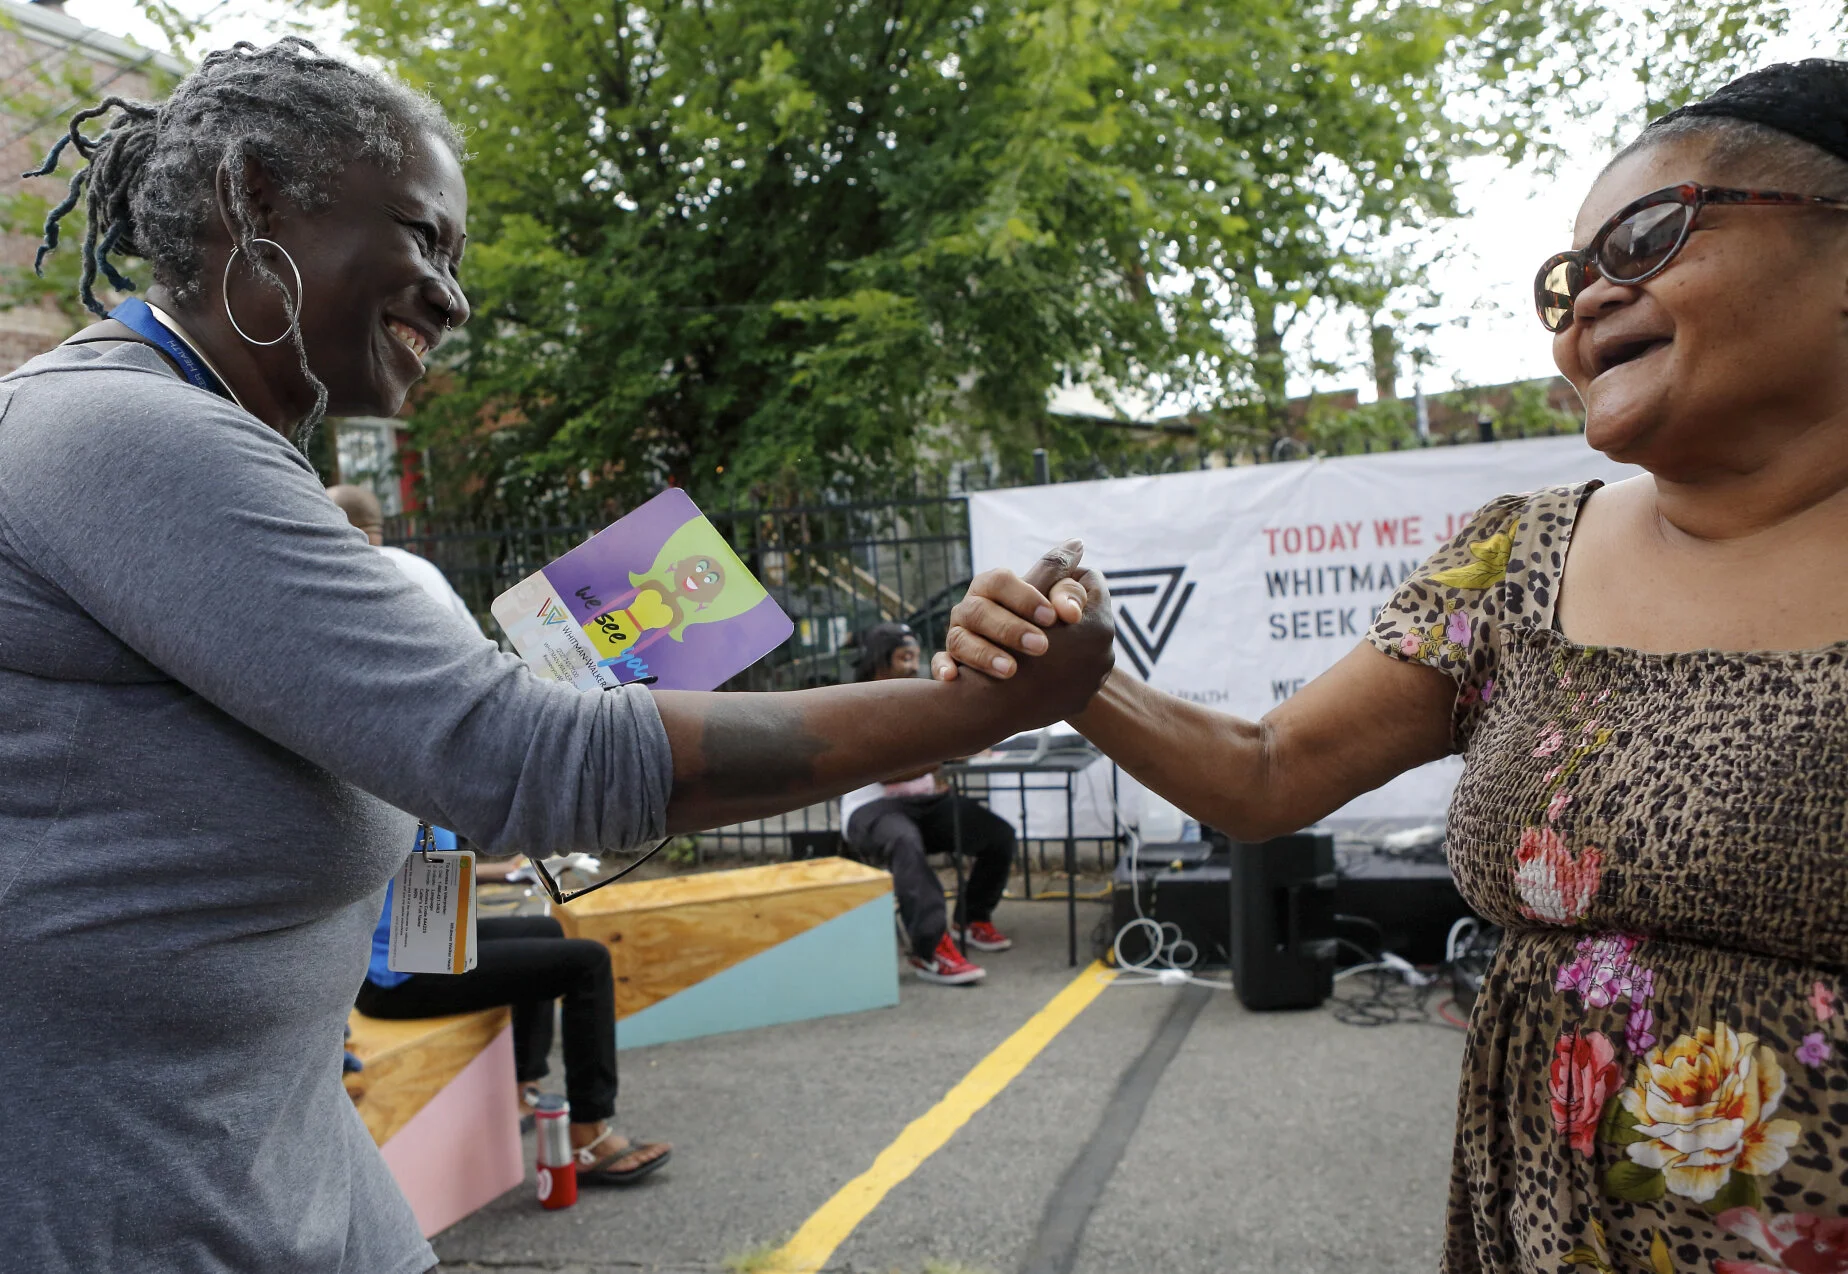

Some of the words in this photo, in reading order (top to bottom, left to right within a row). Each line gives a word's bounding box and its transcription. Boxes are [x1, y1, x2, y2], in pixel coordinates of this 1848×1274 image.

[166, 340, 198, 372] HEALTH
[1262, 520, 1363, 556] TODAY
[1374, 516, 1424, 548] WE
[1265, 558, 1418, 598] WHITMAN
[575, 585, 602, 610] we
[594, 613, 627, 644] see
[1269, 606, 1358, 640] SEEK
[562, 625, 607, 687] WHITMAN-WALKER
[597, 646, 649, 678] you
